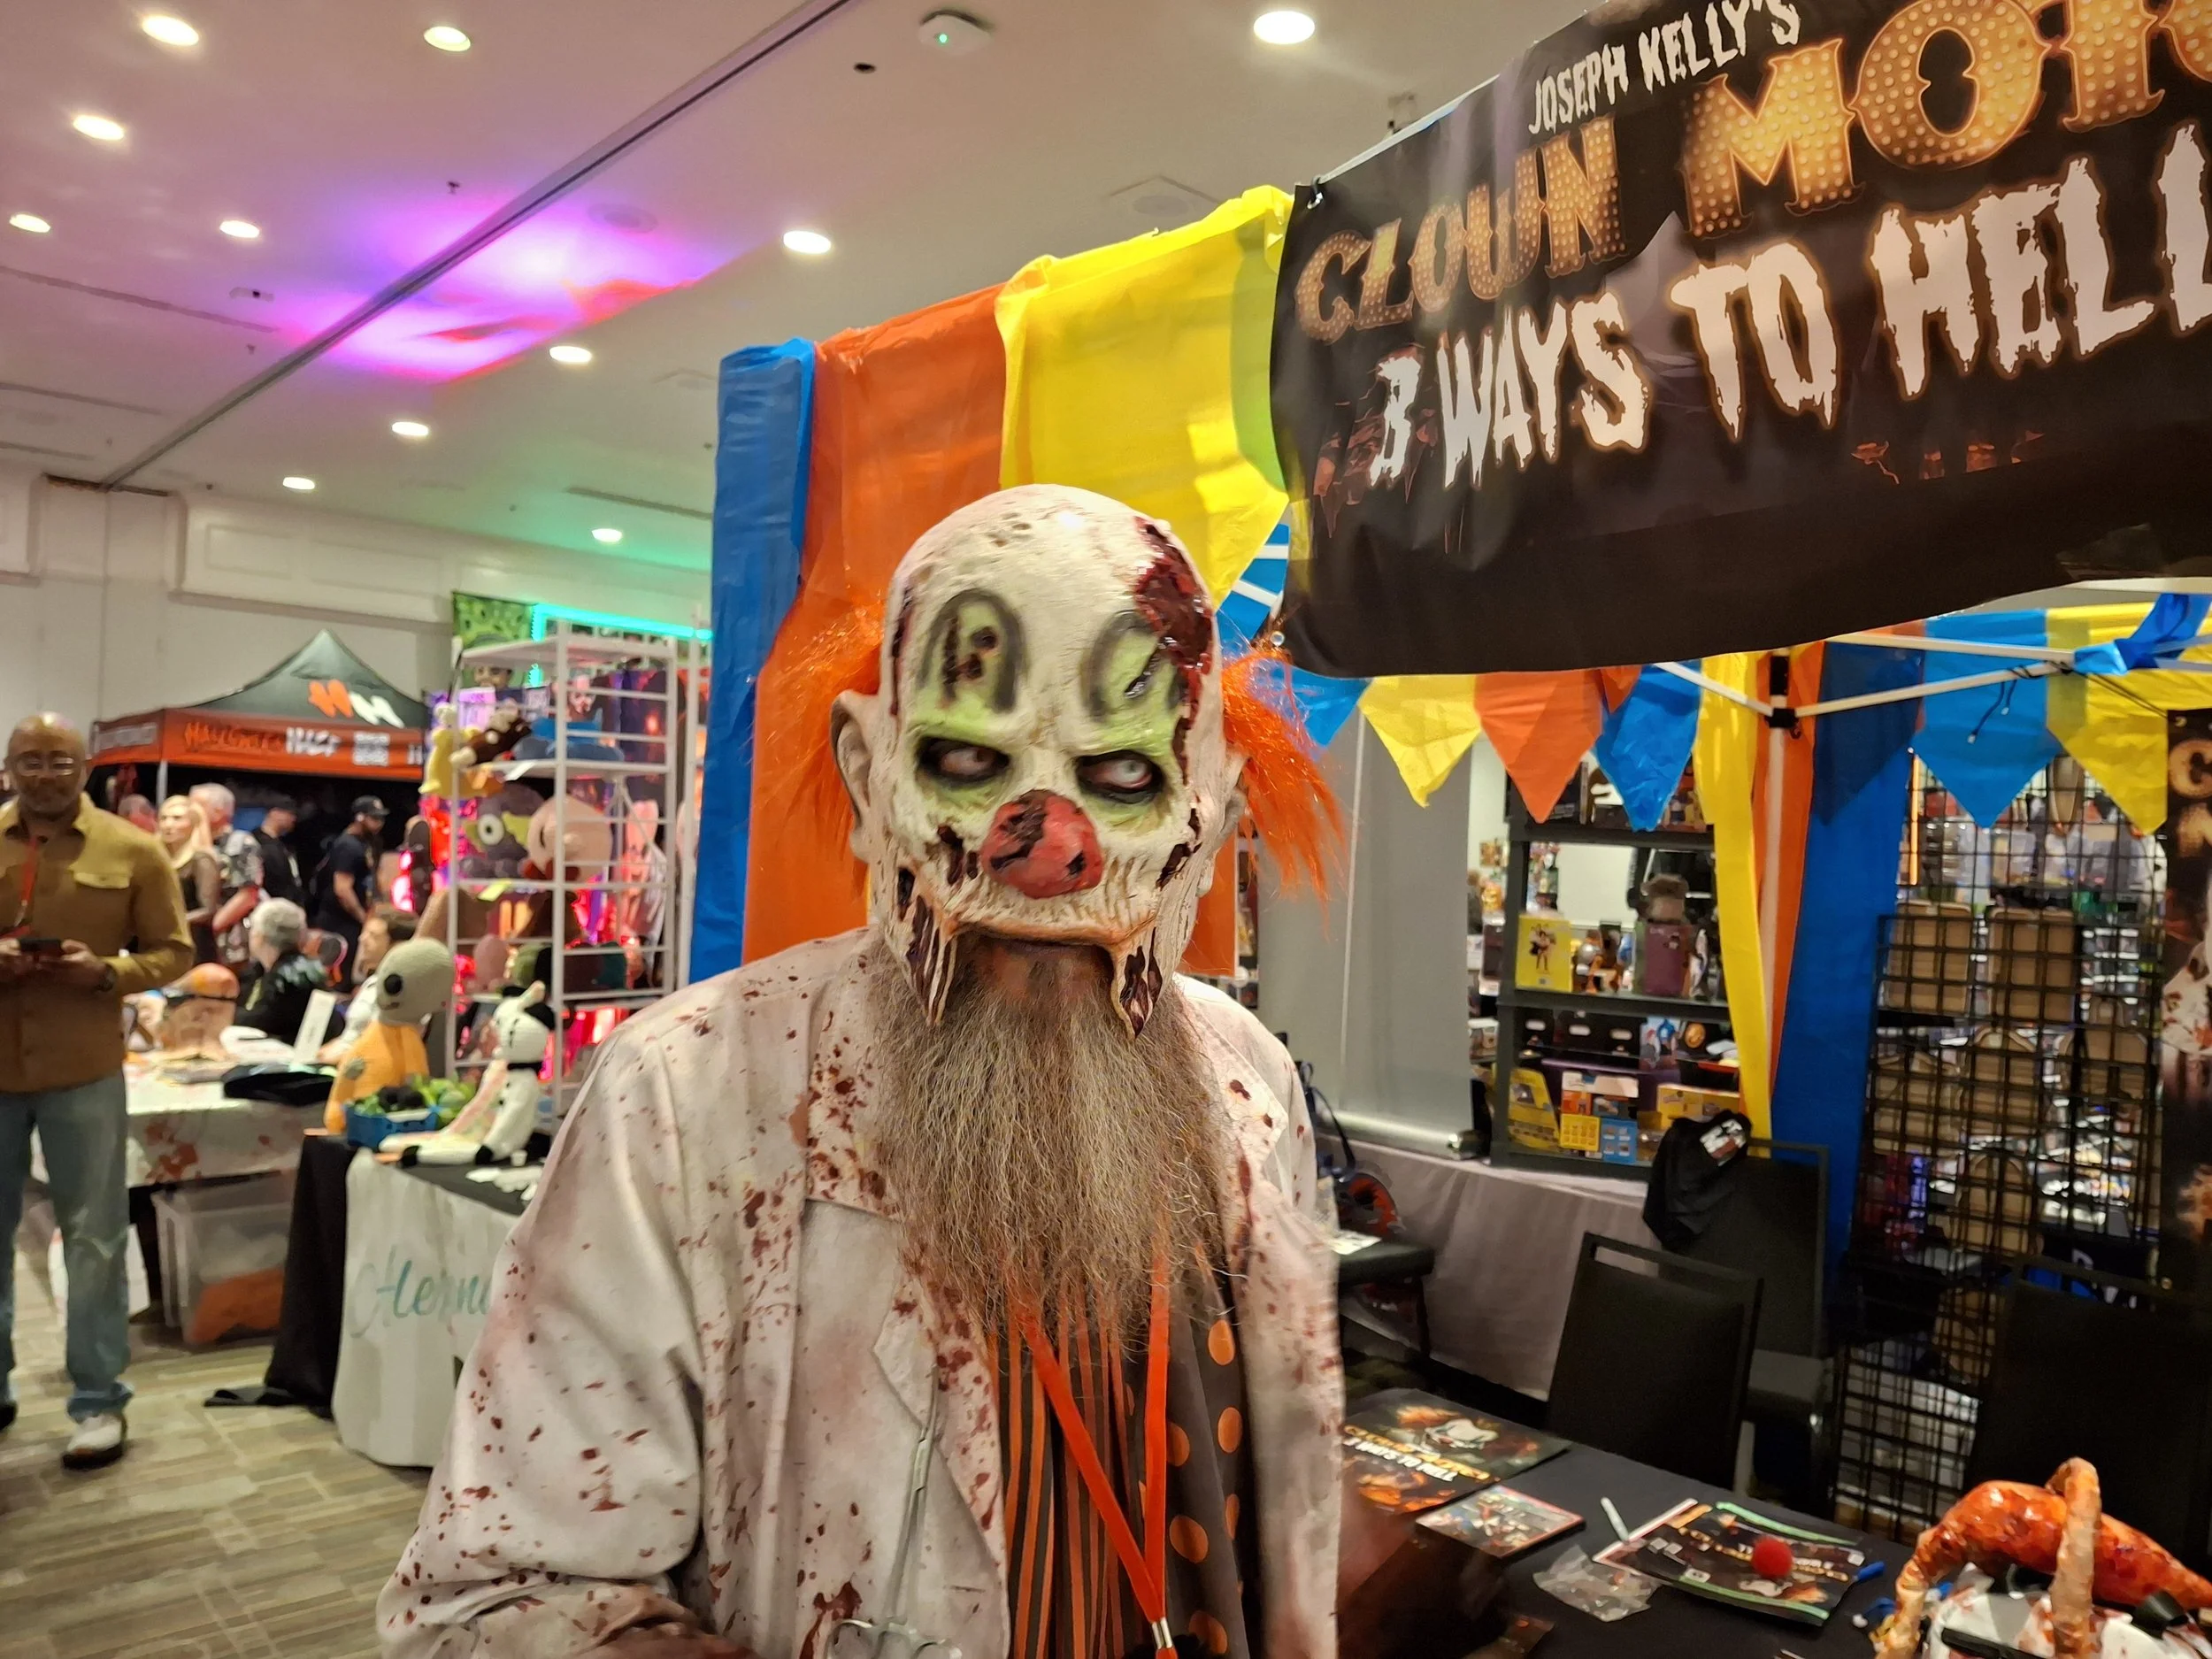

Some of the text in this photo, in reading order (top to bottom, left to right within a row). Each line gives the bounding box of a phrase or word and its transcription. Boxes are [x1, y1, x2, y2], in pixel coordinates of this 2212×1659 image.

[1528, 0, 1801, 135] JOSEPH KELLY'S
[1295, 112, 1628, 345] CLOWN
[1436, 292, 1648, 488] WAYS
[1671, 242, 1838, 440] TO
[1870, 124, 2212, 397] HELL
